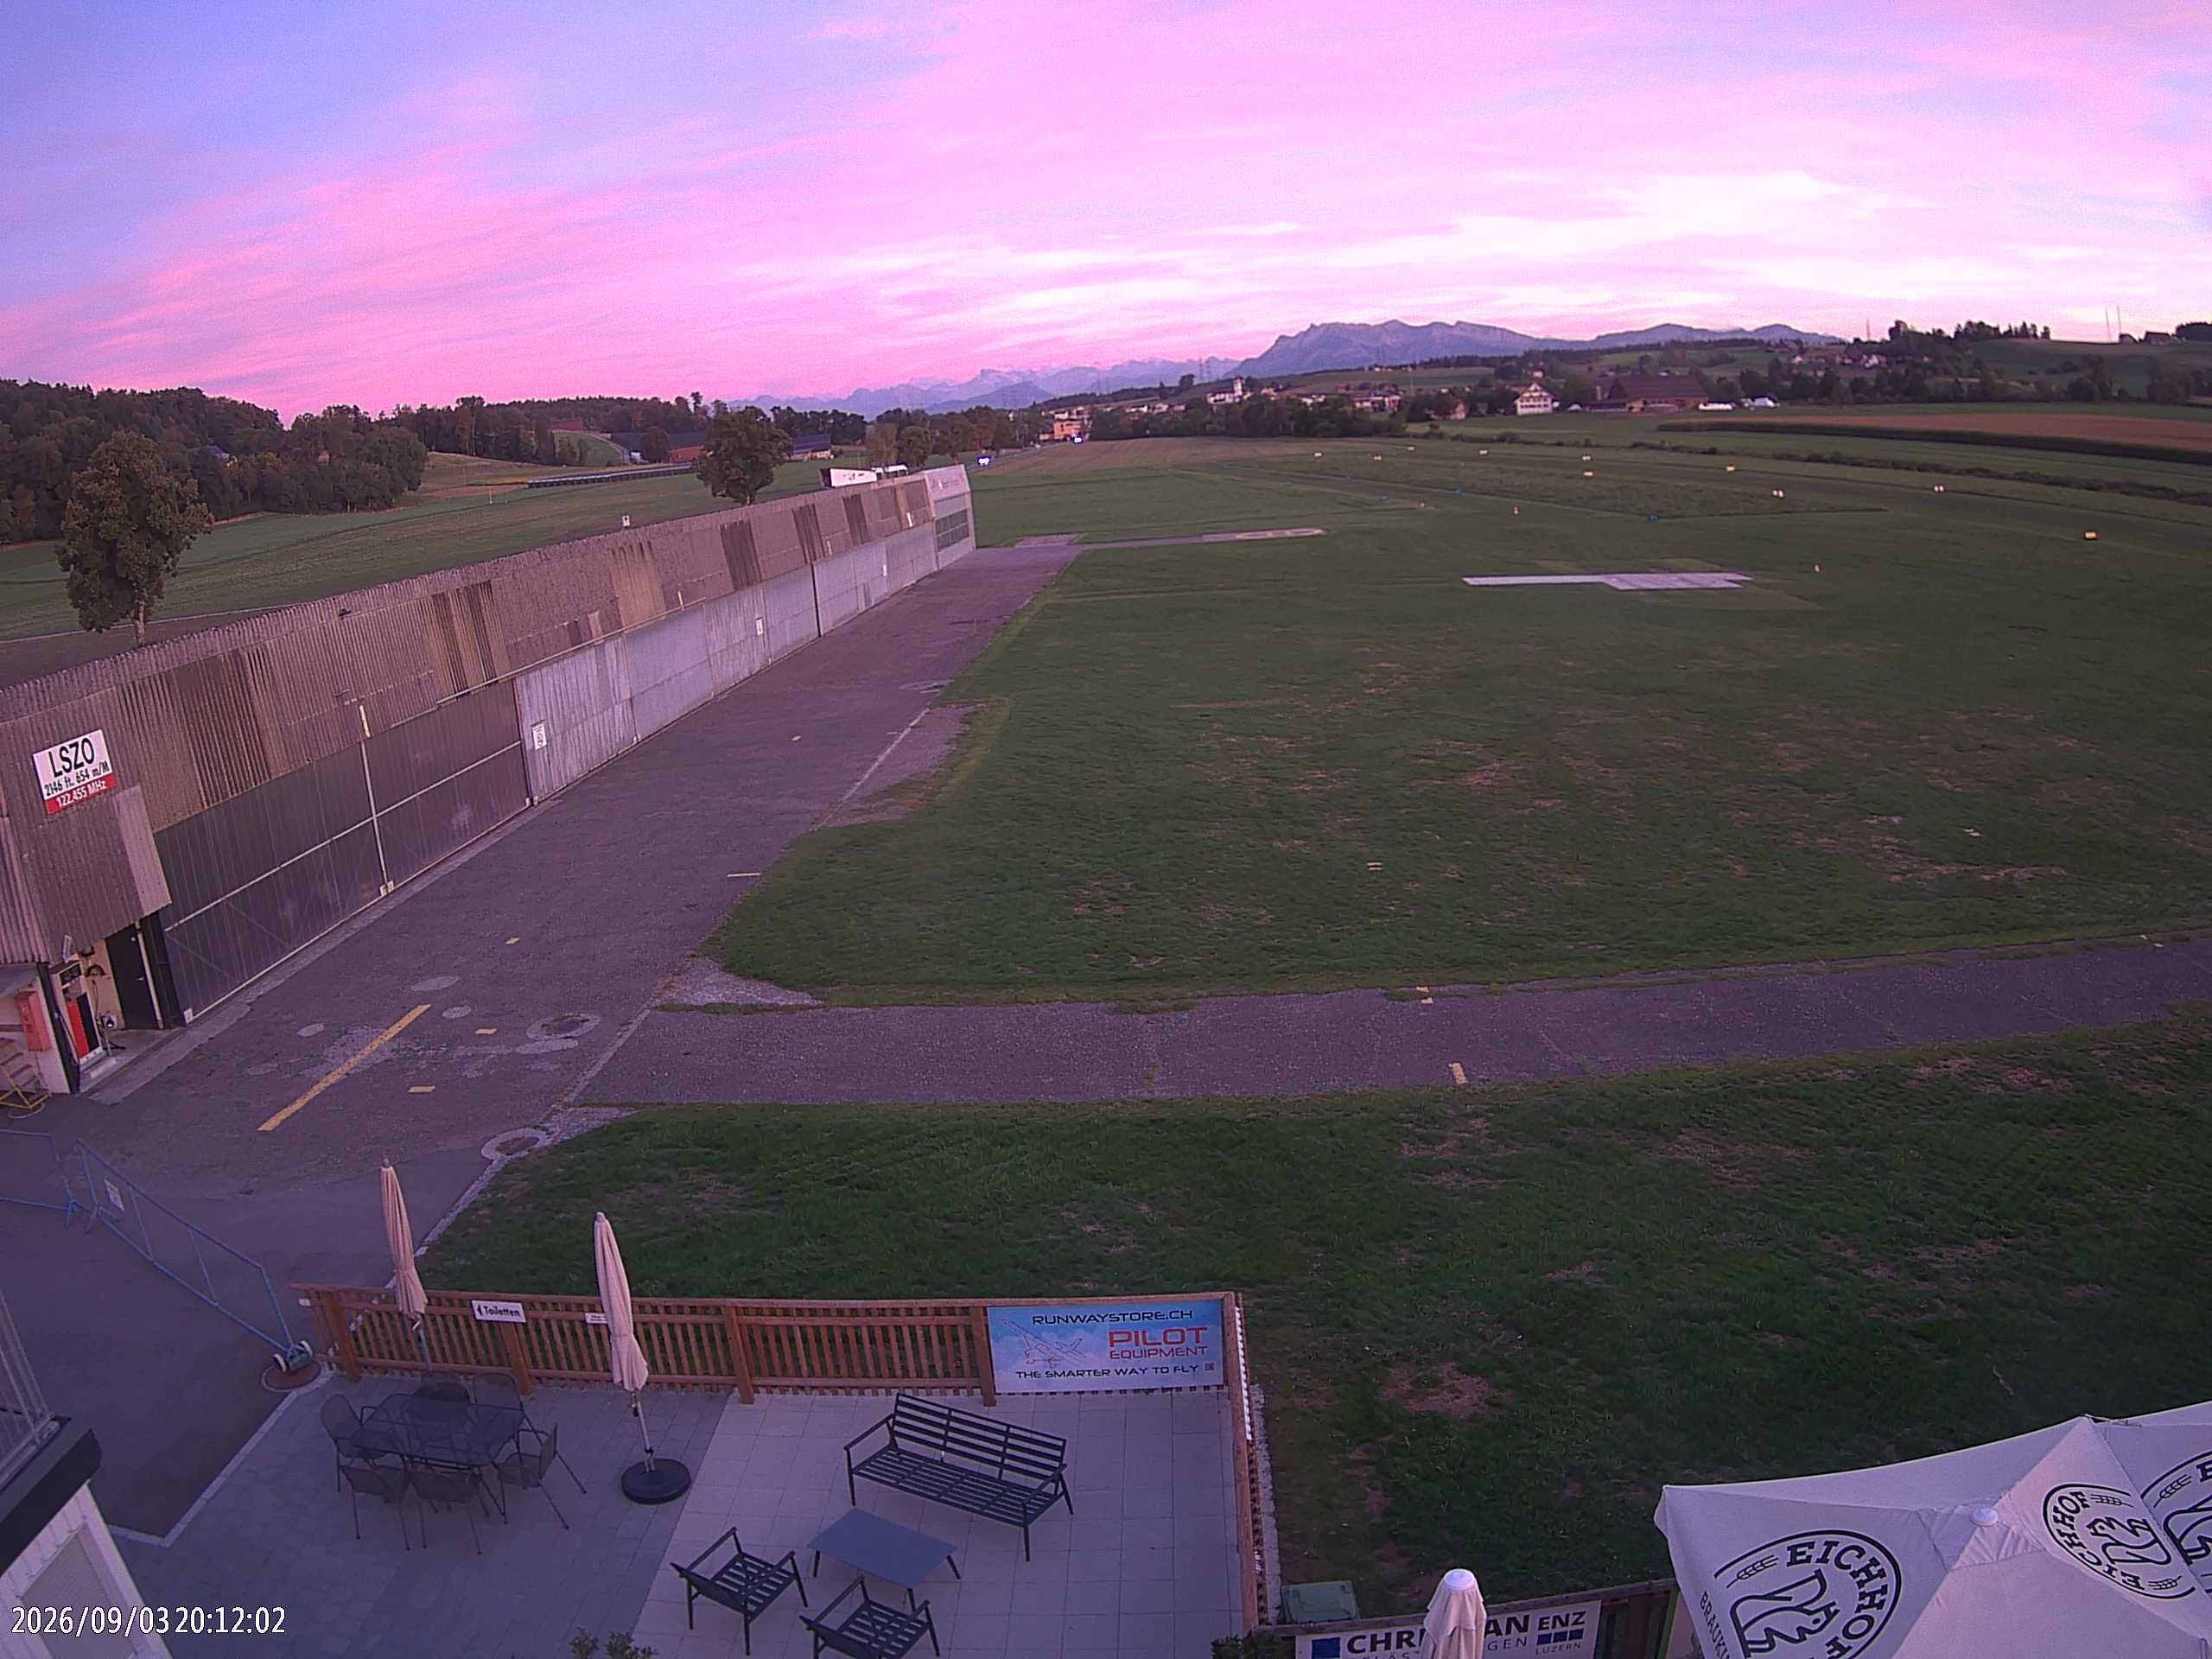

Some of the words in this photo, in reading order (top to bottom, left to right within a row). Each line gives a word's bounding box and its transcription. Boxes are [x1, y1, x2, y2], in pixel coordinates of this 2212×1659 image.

[48, 738, 94, 778] LSZO
[44, 781, 63, 797] 2146
[76, 768, 90, 784] 654
[56, 785, 87, 808] 122.455
[87, 779, 107, 795] MHz
[483, 1306, 520, 1317] Toiletten
[1033, 1310, 1192, 1325] RUNWAYSTORE.CH
[1109, 1326, 1208, 1347] PILOT
[1110, 1345, 1208, 1359] EQUIPMENT
[1016, 1370, 1041, 1379] THE
[1046, 1369, 1111, 1379] SMARTER
[1114, 1367, 1147, 1376] WAY
[1153, 1366, 1169, 1375] TO
[1173, 1364, 1198, 1374] FLY
[2053, 1491, 2145, 1591] EICHHOF
[1787, 1541, 1888, 1659] EICHHOF
[1538, 1611, 1586, 1630] ENZ
[1535, 1643, 1581, 1655] LUZERN
